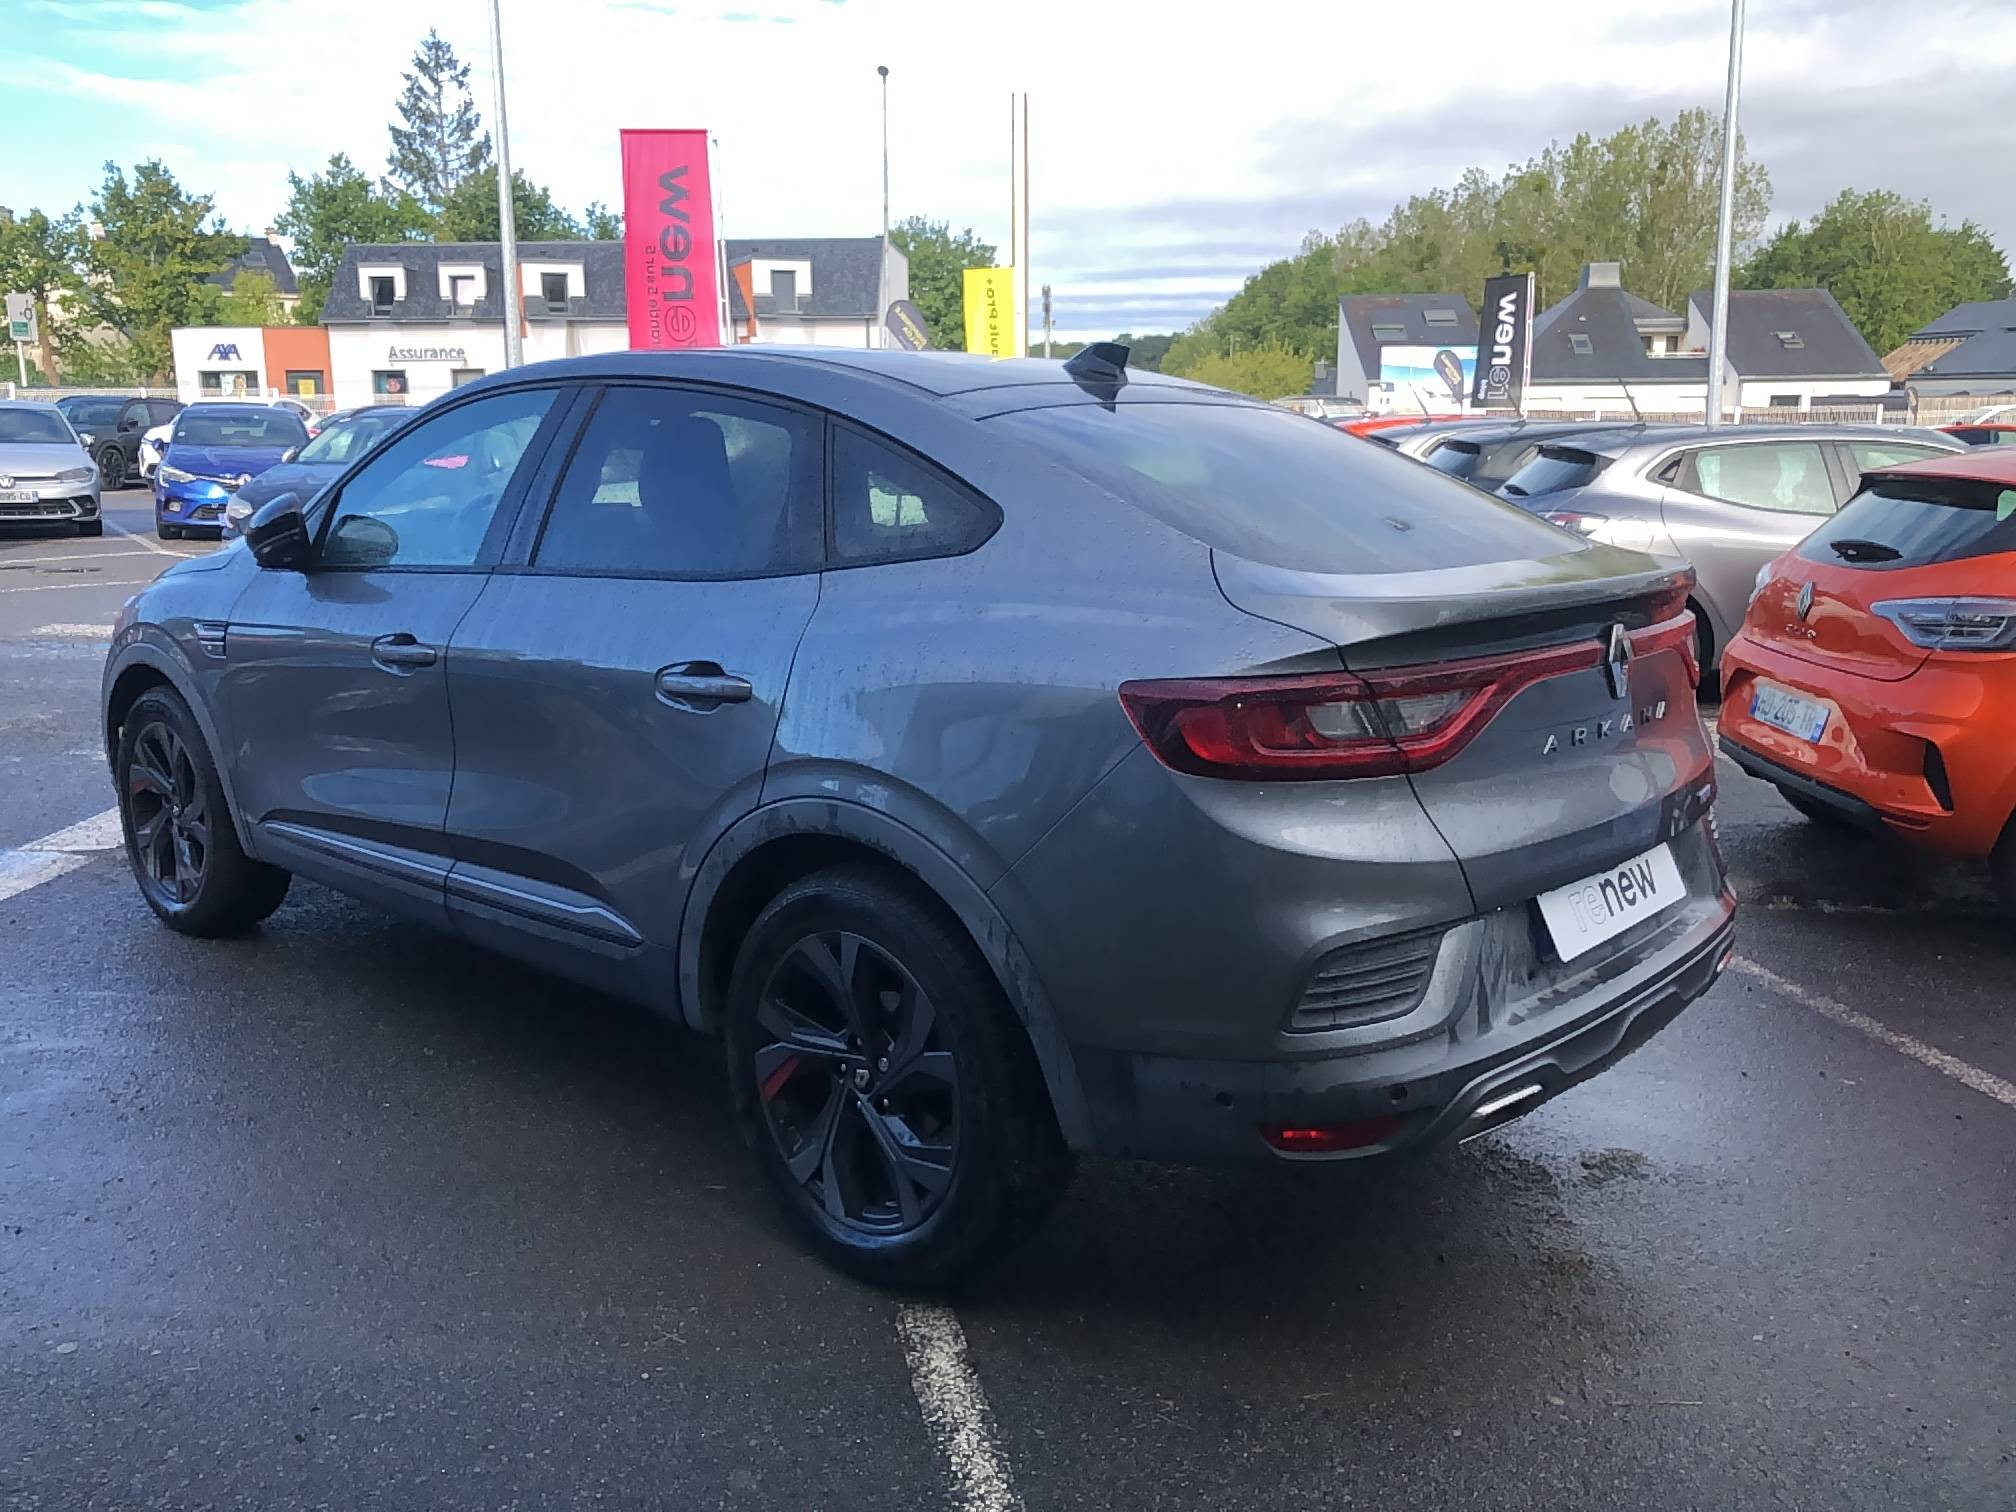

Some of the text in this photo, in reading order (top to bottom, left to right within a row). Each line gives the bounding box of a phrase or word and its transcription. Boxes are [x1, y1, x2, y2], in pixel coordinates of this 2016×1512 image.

[207, 343, 242, 361] AXA
[388, 345, 465, 360] Assurance
[1567, 858, 1657, 933] renew
